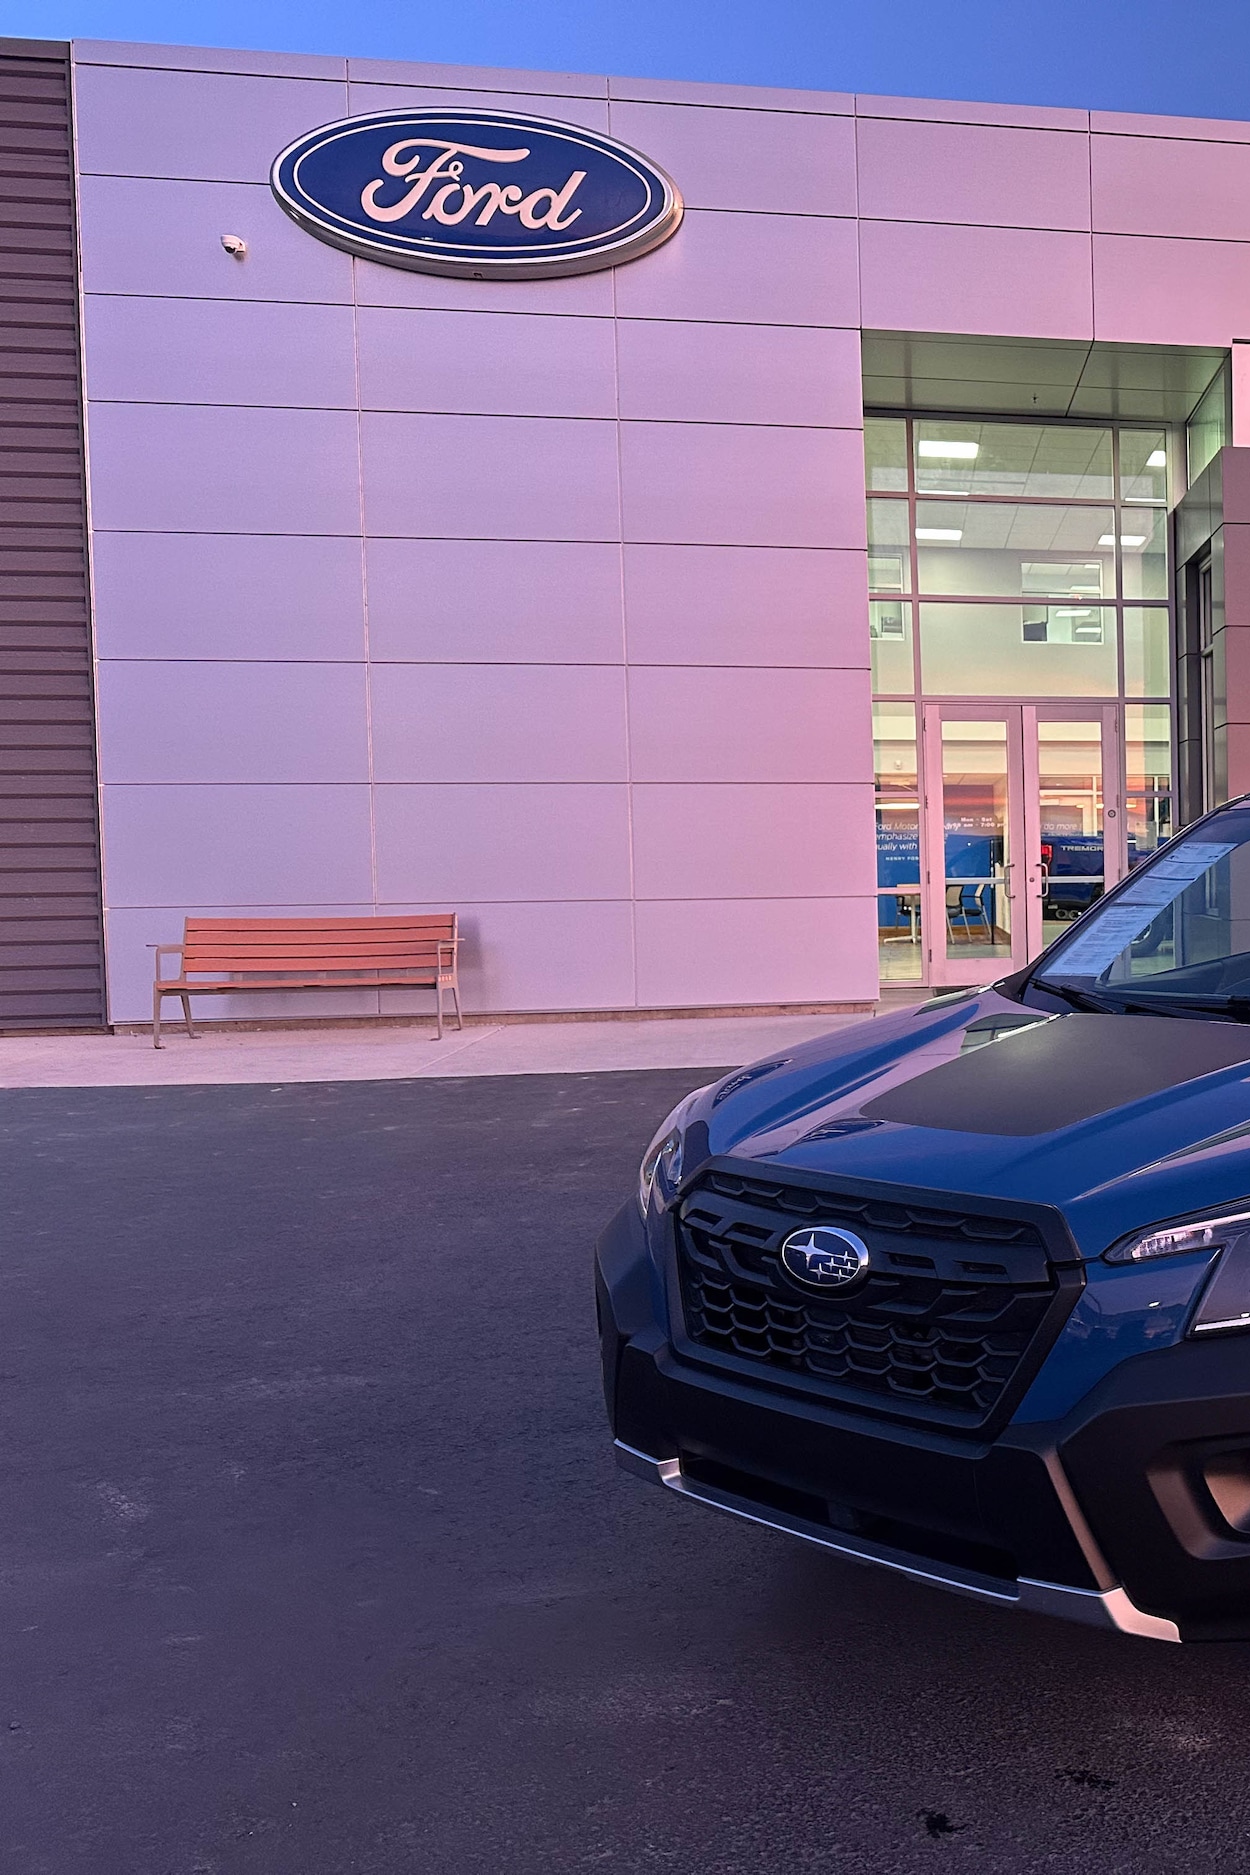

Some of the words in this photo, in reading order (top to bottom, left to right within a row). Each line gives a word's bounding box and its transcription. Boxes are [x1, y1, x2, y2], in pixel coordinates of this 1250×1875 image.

[360, 138, 587, 231] Ford
[893, 822, 919, 831] Motor
[899, 842, 918, 850] with
